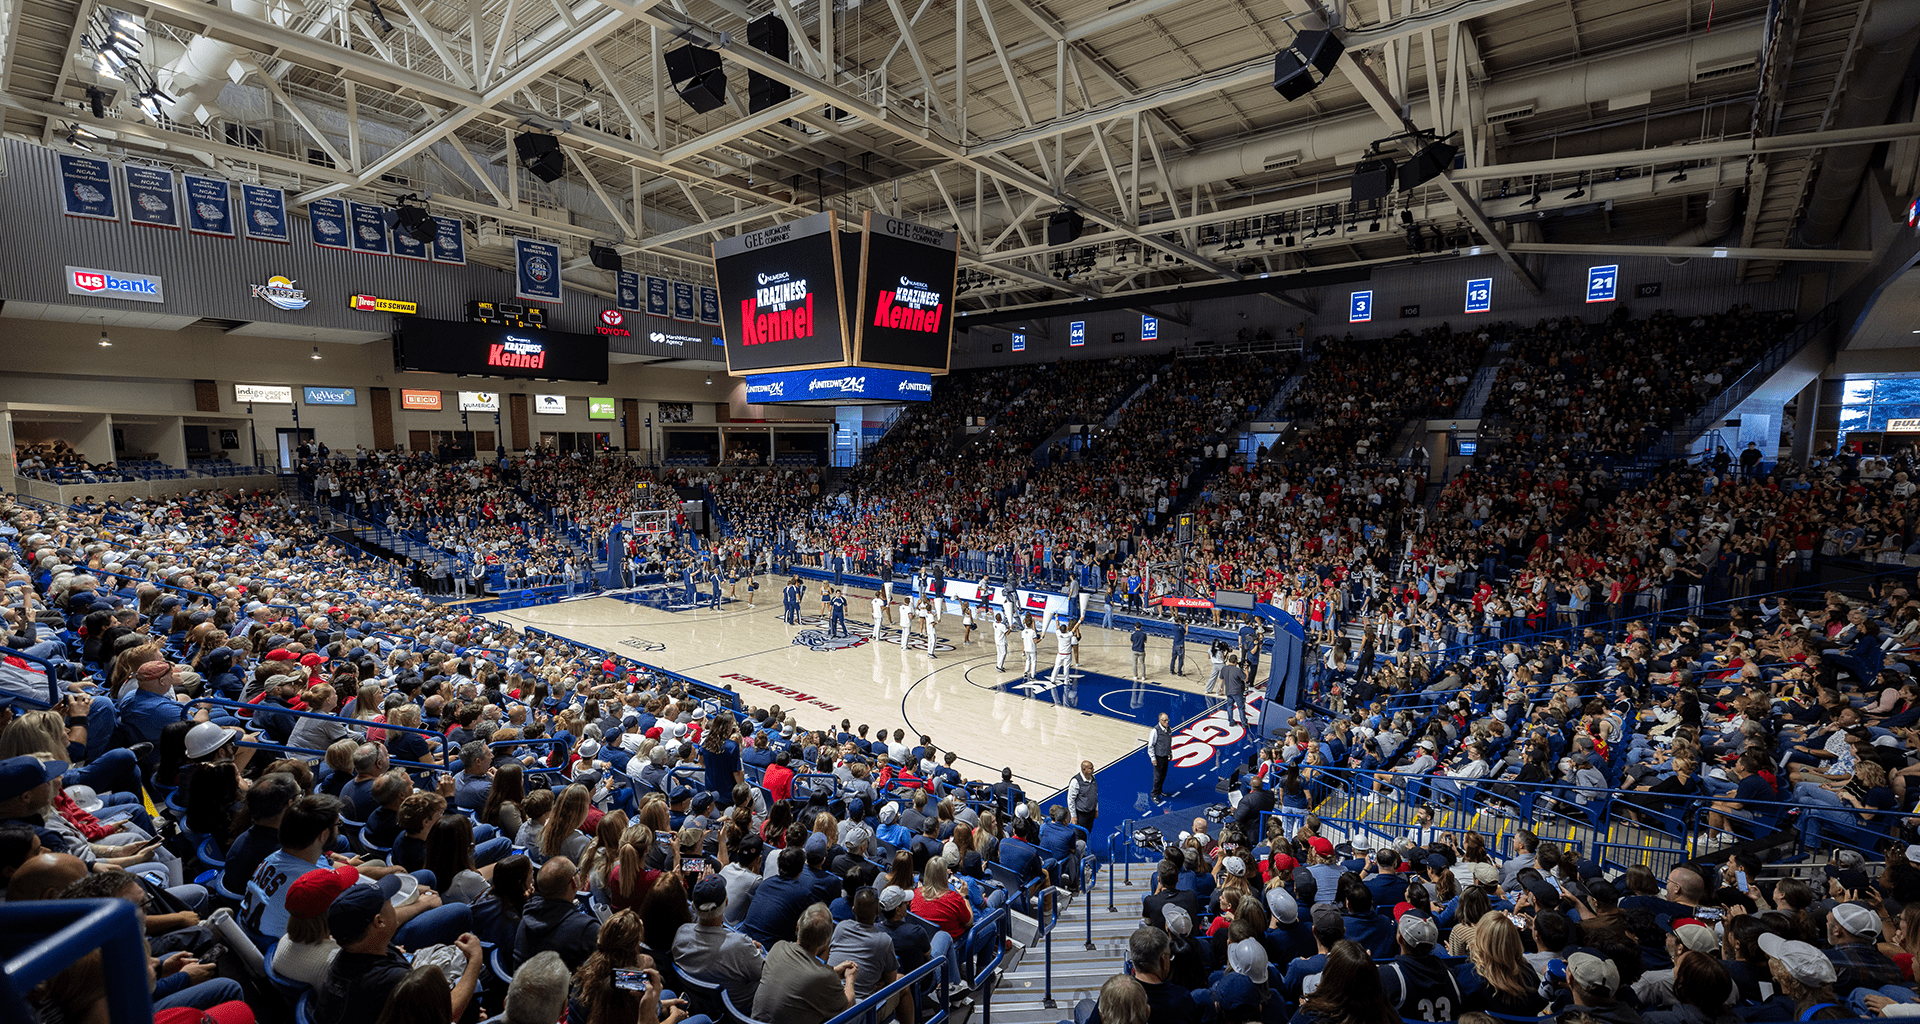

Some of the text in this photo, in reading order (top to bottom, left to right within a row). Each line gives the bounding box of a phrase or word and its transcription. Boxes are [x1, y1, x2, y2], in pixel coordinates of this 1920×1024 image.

[64, 172, 88, 180] Second
[76, 168, 97, 176] NCAA
[129, 182, 152, 190] Second
[764, 224, 791, 237] AUTOMOTIVE
[886, 219, 911, 238] GEE
[912, 225, 945, 240] AUTOMOTIVE
[744, 231, 764, 249] GEE
[765, 233, 790, 245] COMPANIES
[912, 232, 942, 246] COMPANIES
[523, 247, 553, 257] BASKETBALL
[531, 262, 546, 270] FINAL
[532, 269, 547, 277] FOUR
[1592, 277, 1613, 290] 21
[251, 284, 307, 301] KALISPEL
[757, 279, 807, 308] KRAZINESS
[1469, 289, 1488, 301] 13
[1641, 286, 1658, 294] 107
[357, 296, 375, 306] Tires
[895, 286, 940, 307] KRAZINESS
[376, 301, 416, 312] LES SCHWAB
[873, 290, 943, 333] Kennel
[1356, 301, 1366, 311] 3
[741, 292, 814, 347] Kennel
[596, 326, 631, 337] TOYOTA
[1144, 322, 1156, 331] 12
[1014, 335, 1023, 343] 21
[1072, 329, 1083, 337] 44
[504, 342, 542, 353] KRAZINESS
[488, 343, 546, 369] Kennel
[237, 387, 264, 398] indigo
[307, 390, 345, 402] AgWest
[718, 673, 842, 712] The Kennel
[1418, 996, 1452, 1022] 33
